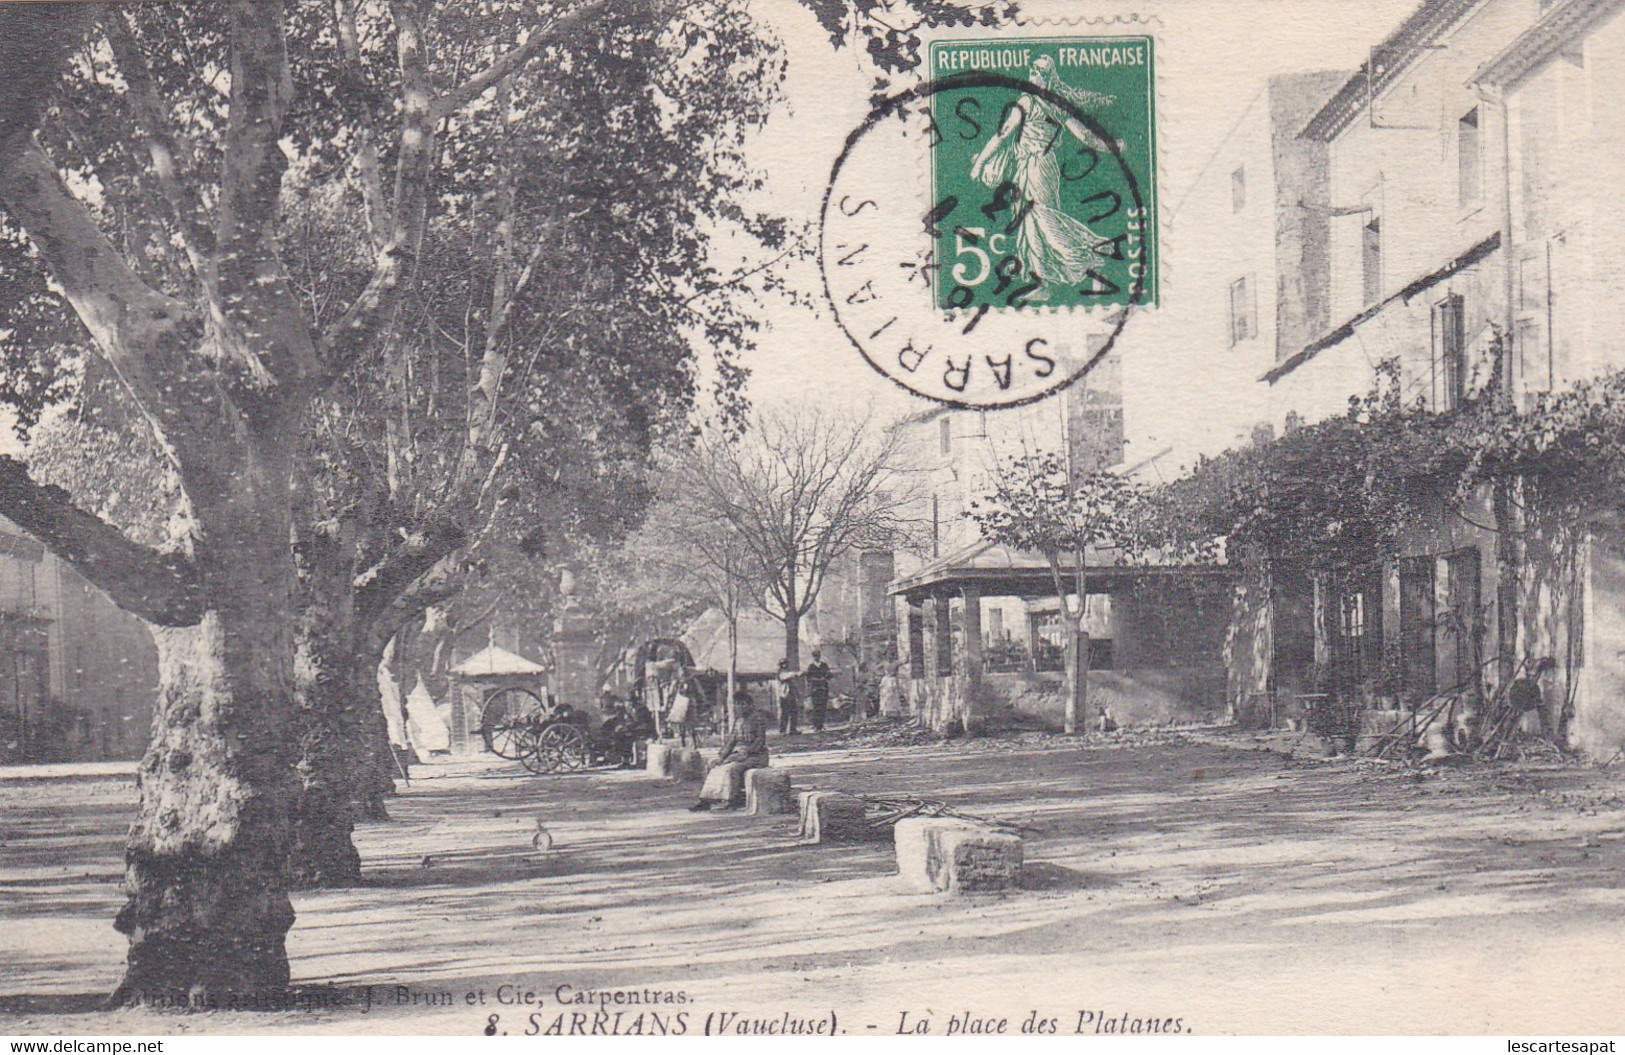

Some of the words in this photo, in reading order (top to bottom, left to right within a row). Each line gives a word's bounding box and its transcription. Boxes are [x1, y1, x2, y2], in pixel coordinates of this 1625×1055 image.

[1058, 46, 1144, 69] FRANÇAISE
[1127, 206, 1147, 296] POSTES
[838, 195, 1055, 392] SARRIANS
[360, 985, 382, 1014] J.
[396, 986, 454, 1006] Brun
[465, 989, 487, 1006] et
[497, 984, 544, 1009] Cie,
[555, 985, 695, 1012] Carpentras.
[485, 1013, 508, 1036] 8.
[524, 1012, 690, 1036] SARRIANS
[704, 1010, 848, 1036] (Vaucluse).
[946, 1010, 1008, 1036] place
[1021, 1010, 1058, 1035] des
[1074, 1010, 1193, 1035] Platanes.
